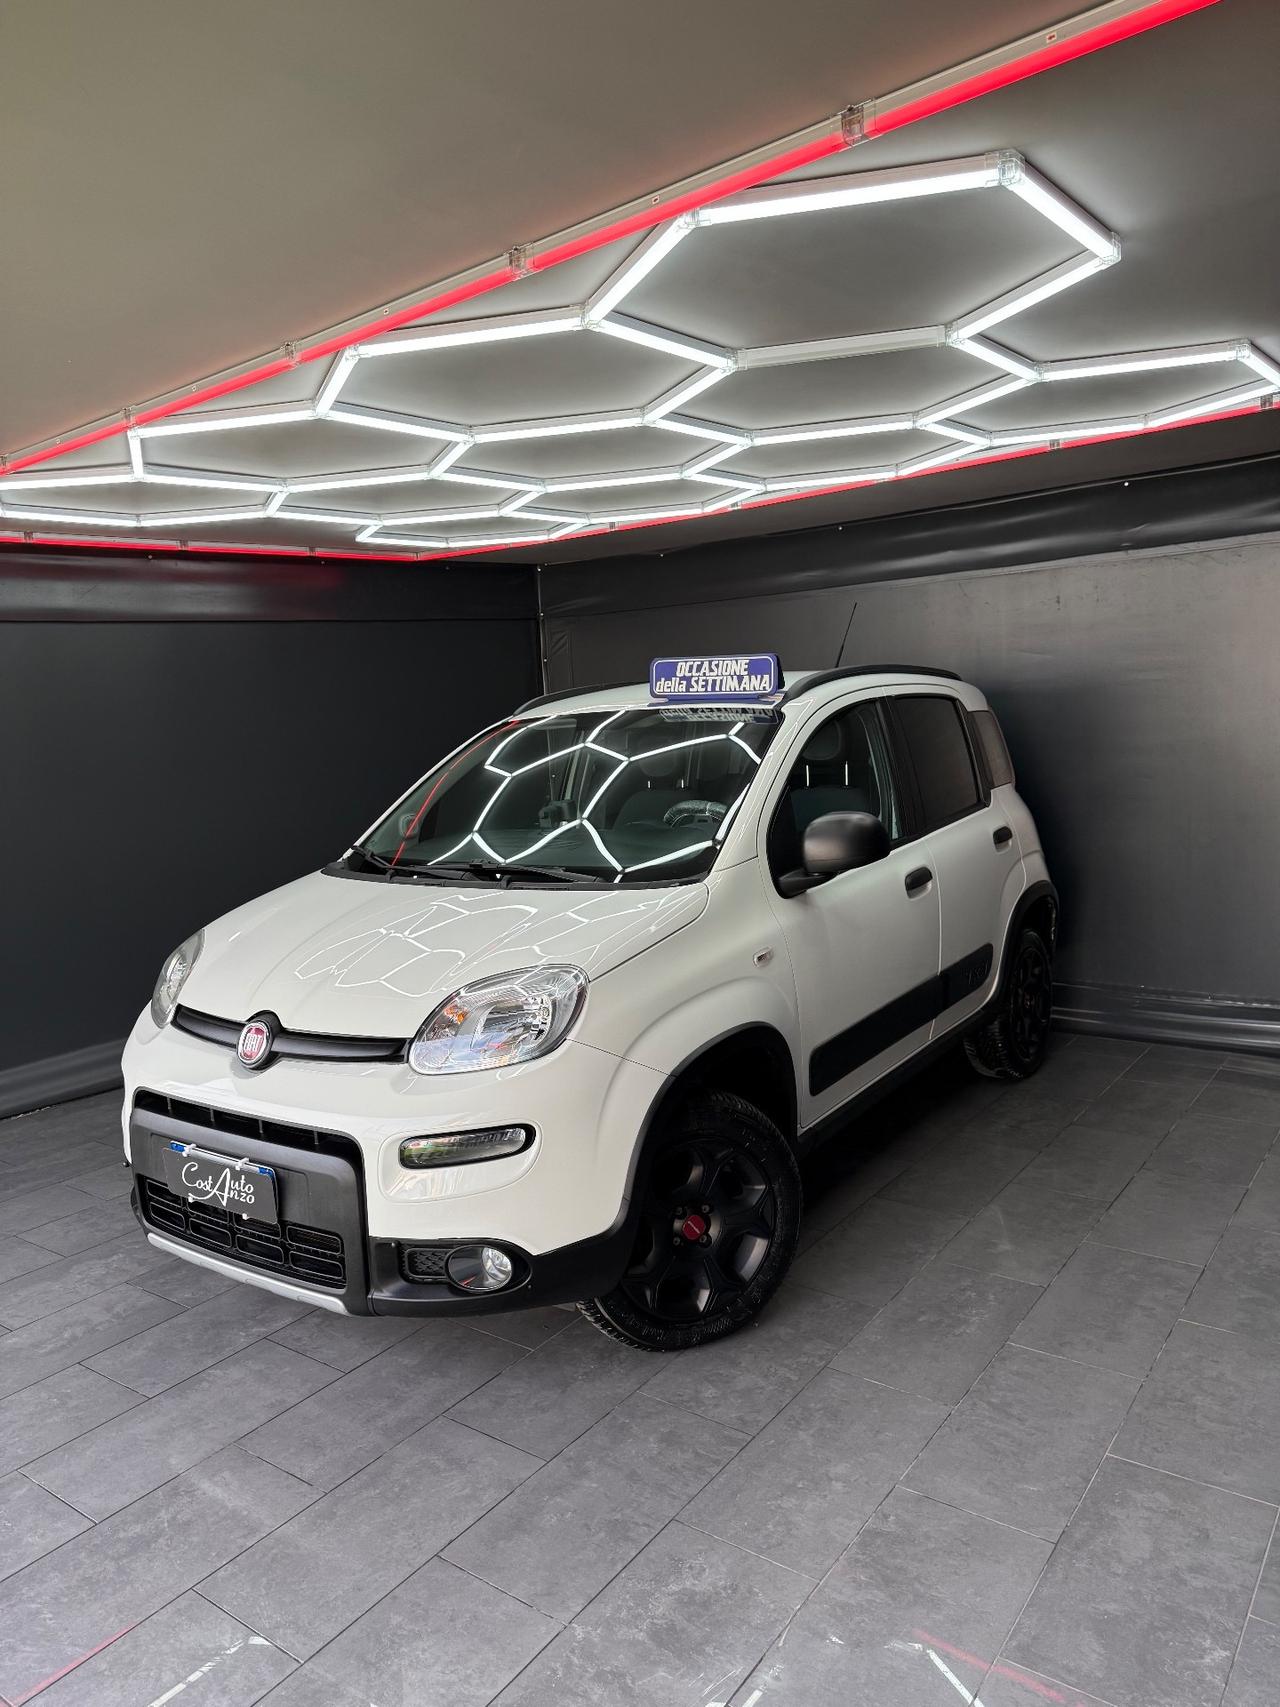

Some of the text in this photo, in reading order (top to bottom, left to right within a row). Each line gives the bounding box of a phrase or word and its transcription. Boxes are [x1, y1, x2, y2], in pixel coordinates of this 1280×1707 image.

[676, 660, 749, 677] OCCASIONE
[656, 675, 770, 693] della SETTIMANA
[182, 1162, 213, 1192] Cost
